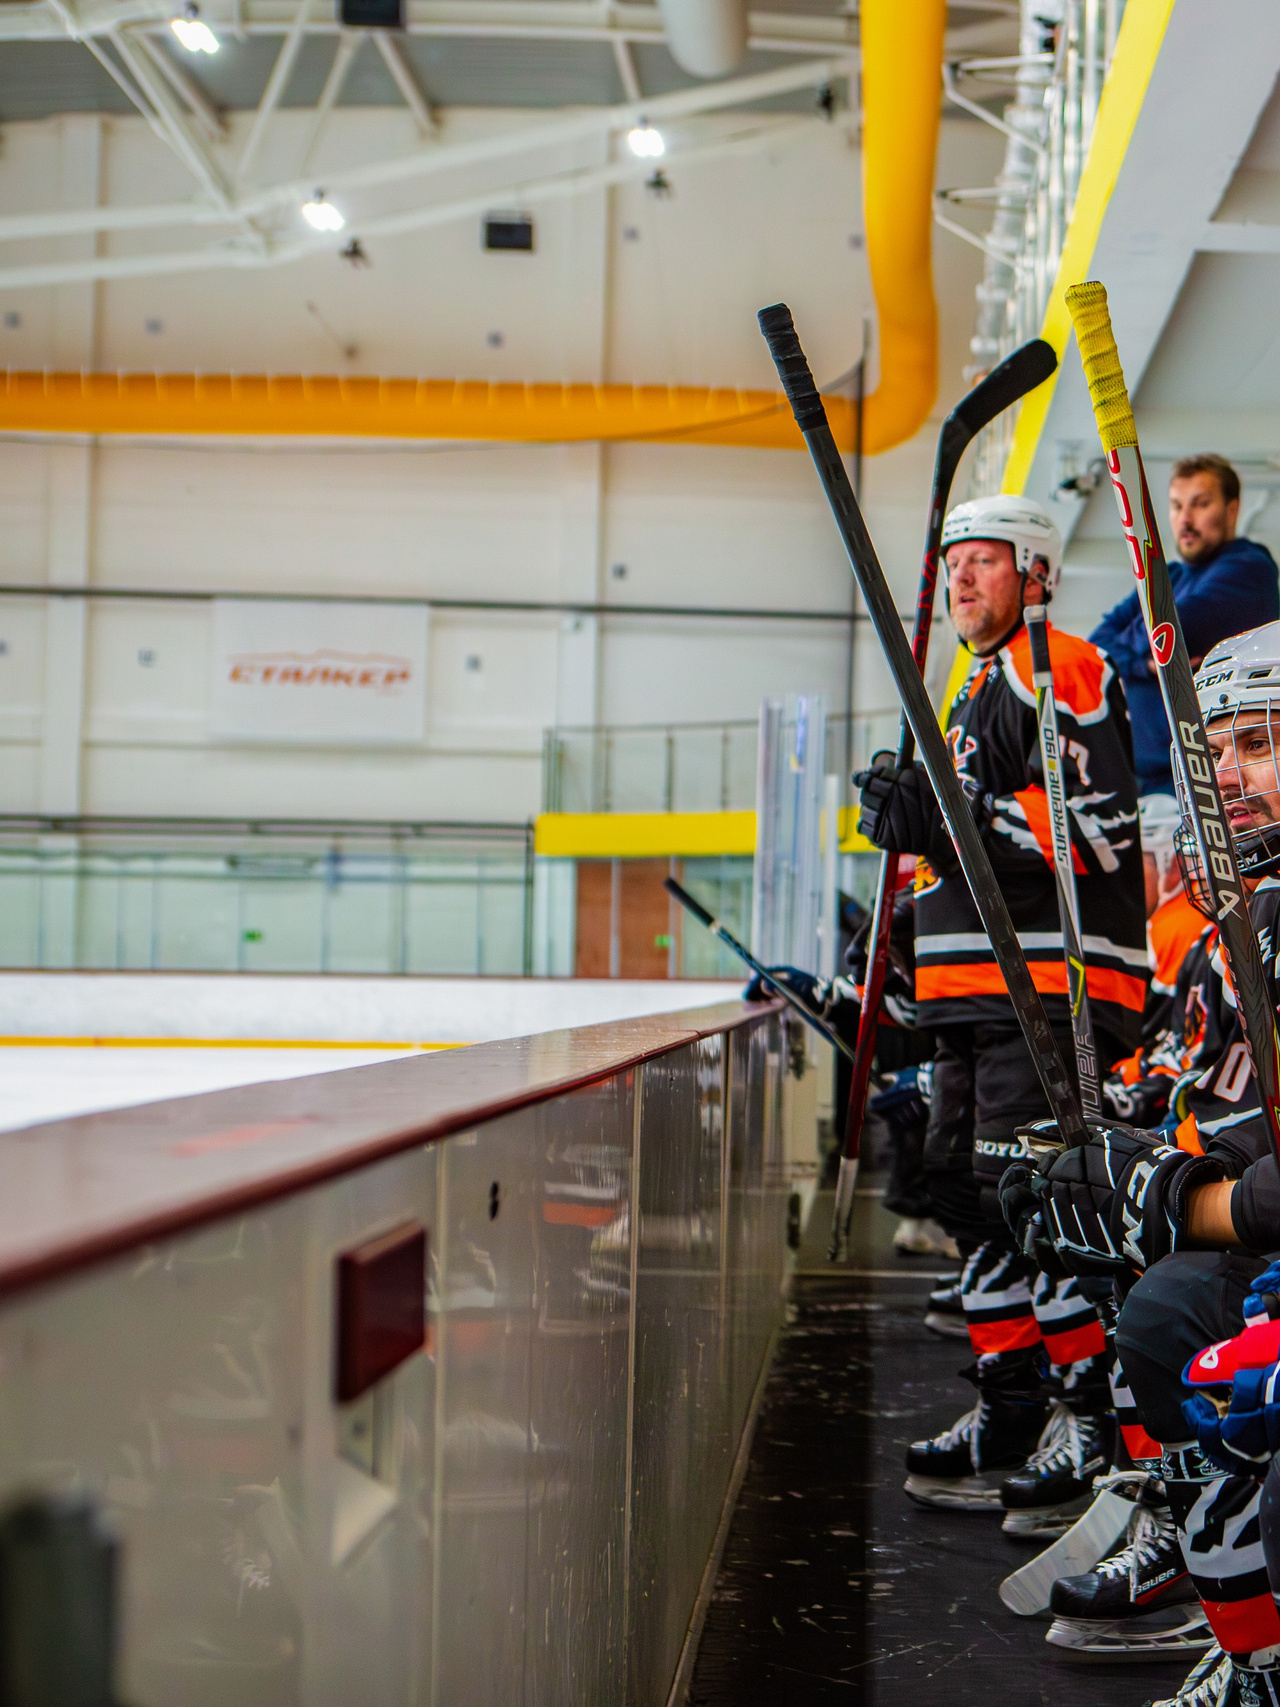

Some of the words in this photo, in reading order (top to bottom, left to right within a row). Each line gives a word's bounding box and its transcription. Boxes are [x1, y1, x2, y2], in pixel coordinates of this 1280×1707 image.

[1195, 670, 1235, 692] CCM
[1049, 772, 1069, 866] SUPREME
[1179, 720, 1236, 882] BAUER
